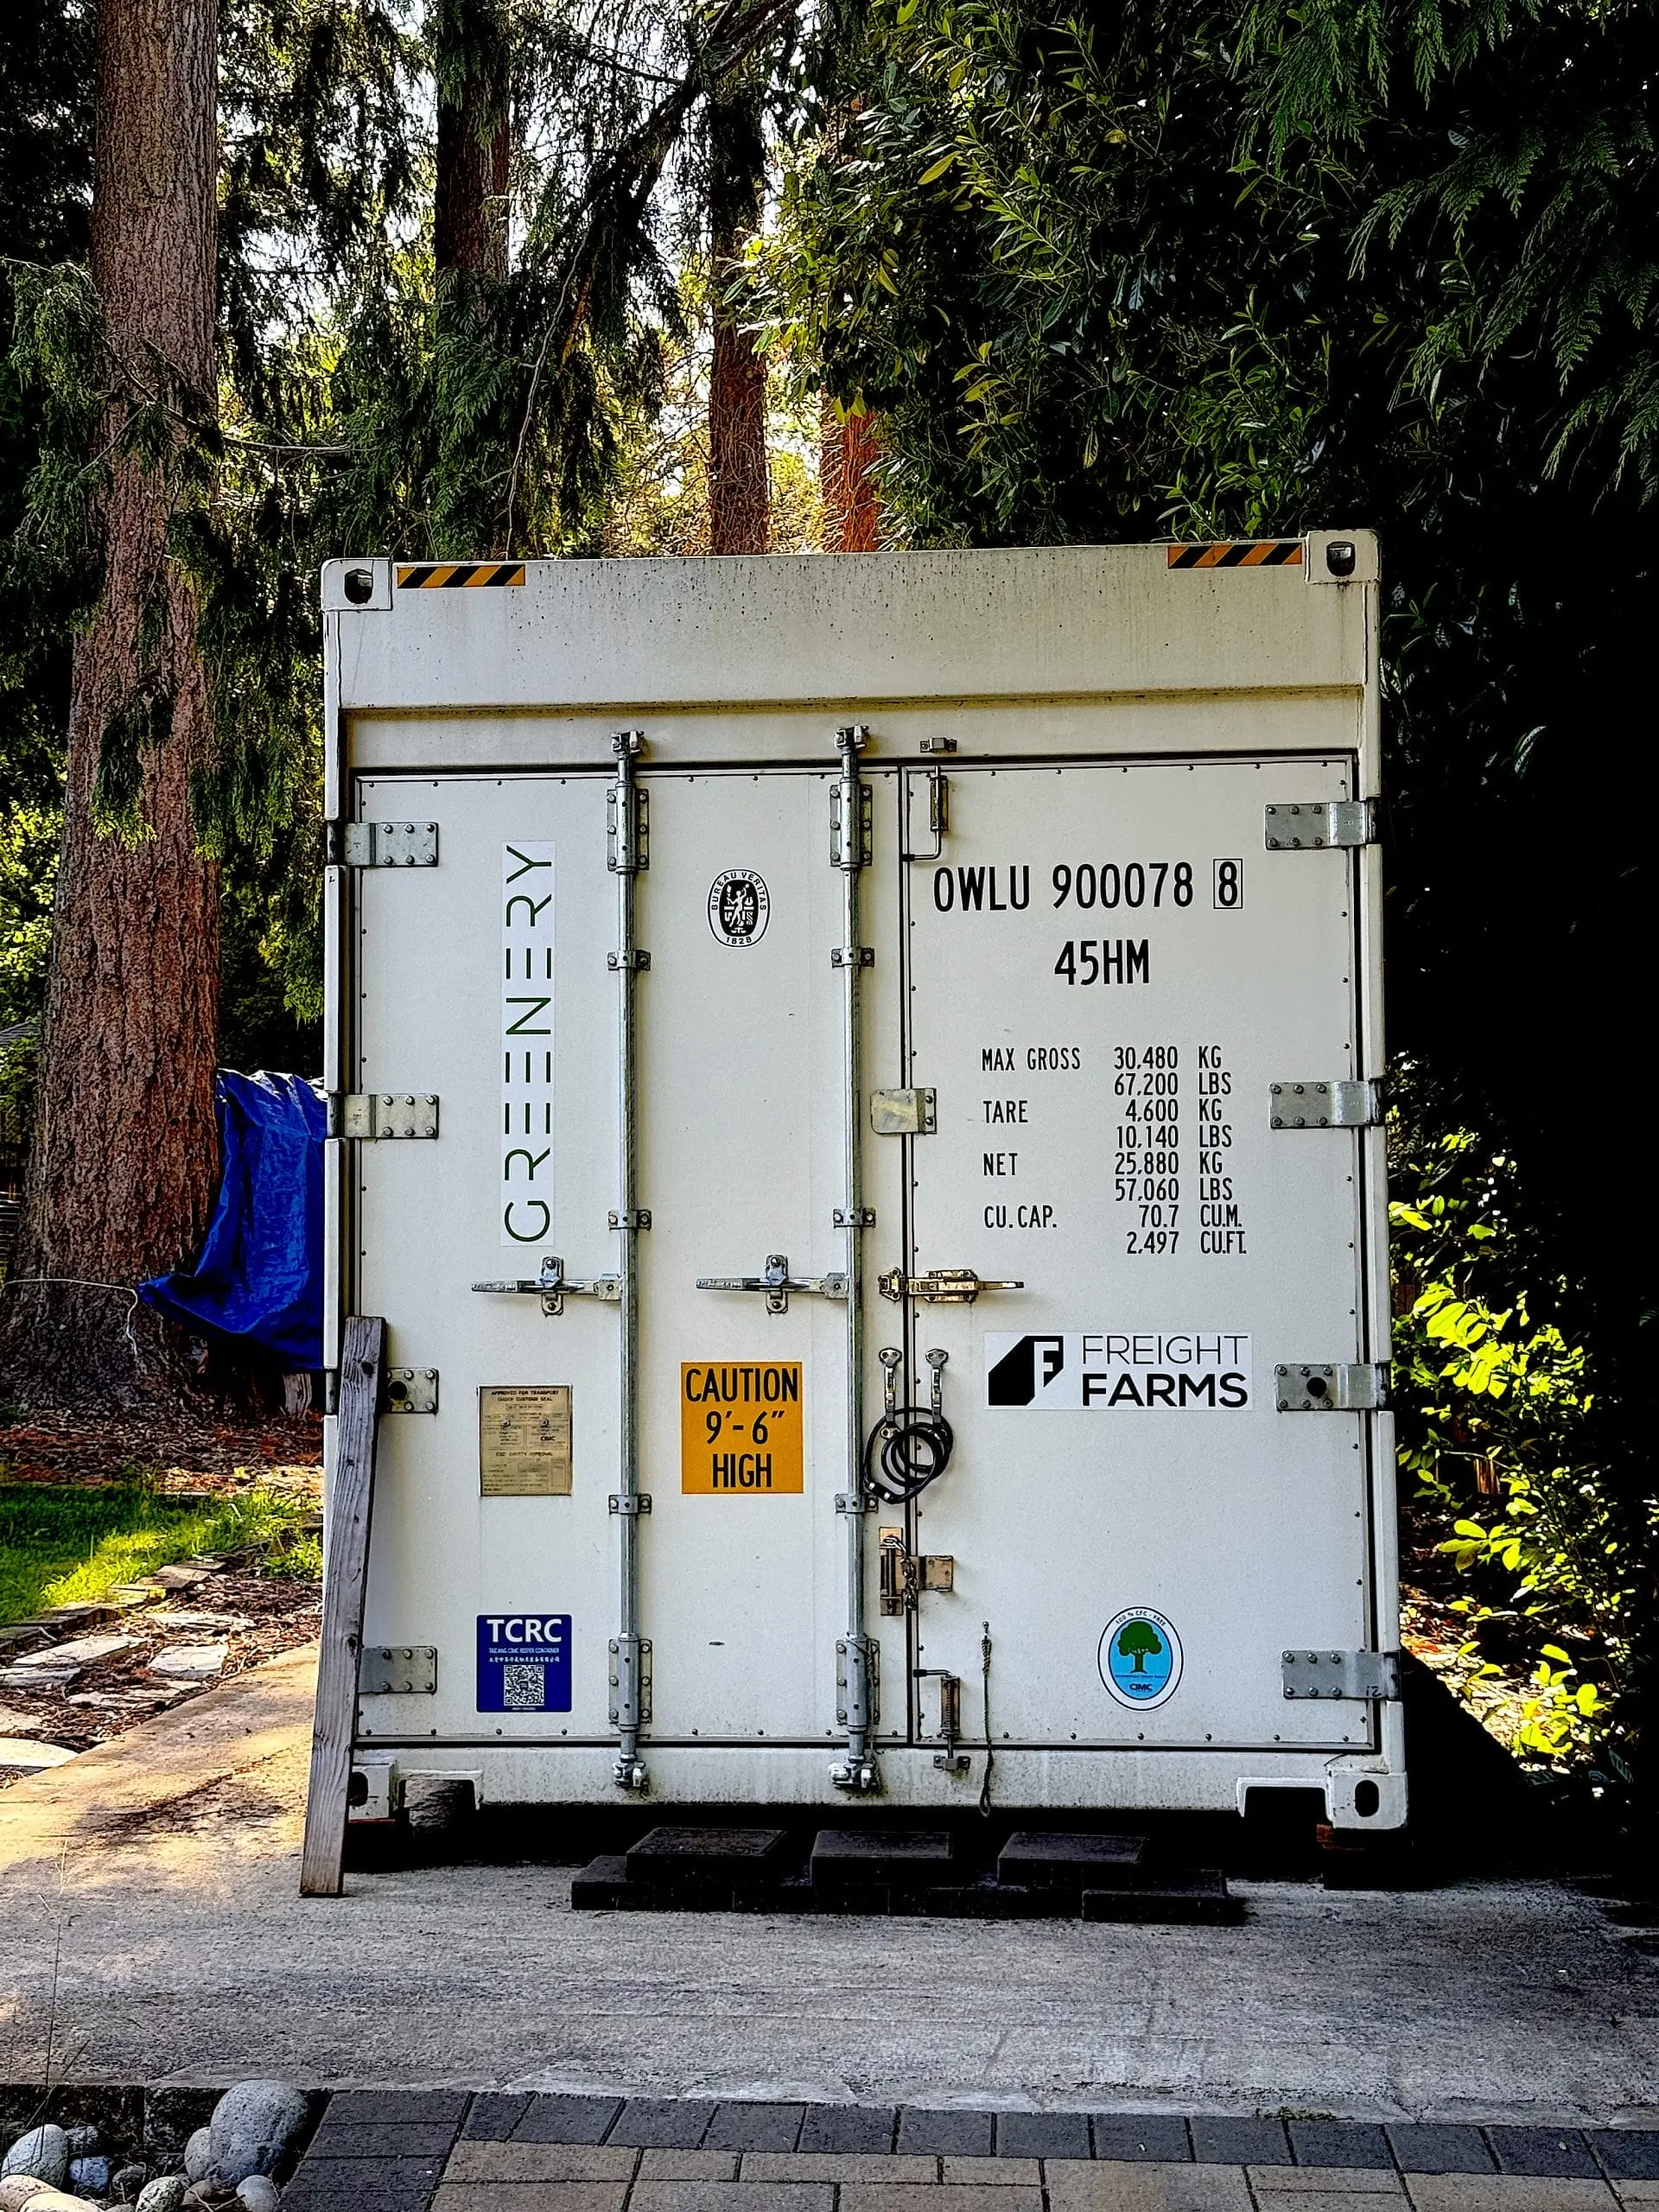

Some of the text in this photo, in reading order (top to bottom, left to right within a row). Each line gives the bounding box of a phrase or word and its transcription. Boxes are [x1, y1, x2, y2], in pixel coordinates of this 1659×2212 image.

[711, 872, 766, 911] BUREAU VERITAS
[933, 861, 1238, 912] OWLU 900078 8
[1054, 938, 1149, 986] 45HM
[504, 843, 552, 1243] GREENERY
[982, 1047, 1015, 1071] MAX
[1027, 1047, 1081, 1071] GROSS
[1198, 1045, 1222, 1069] KG
[1198, 1071, 1231, 1096] LBS
[982, 1100, 1028, 1124] TARE
[1198, 1097, 1222, 1122] KG
[1199, 1124, 1232, 1148] LBS
[983, 1153, 1019, 1176] NET
[1199, 1151, 1223, 1175] KG
[1199, 1177, 1233, 1201] LBS
[1138, 1204, 1179, 1228] 70.7
[1200, 1204, 1243, 1228] CU.M.
[1083, 1335, 1249, 1365] FREIGHT
[685, 1368, 798, 1402] CAUTION
[1082, 1372, 1249, 1408] FARMS
[712, 1453, 772, 1488] HIGH
[486, 1618, 562, 1643] TCRC
